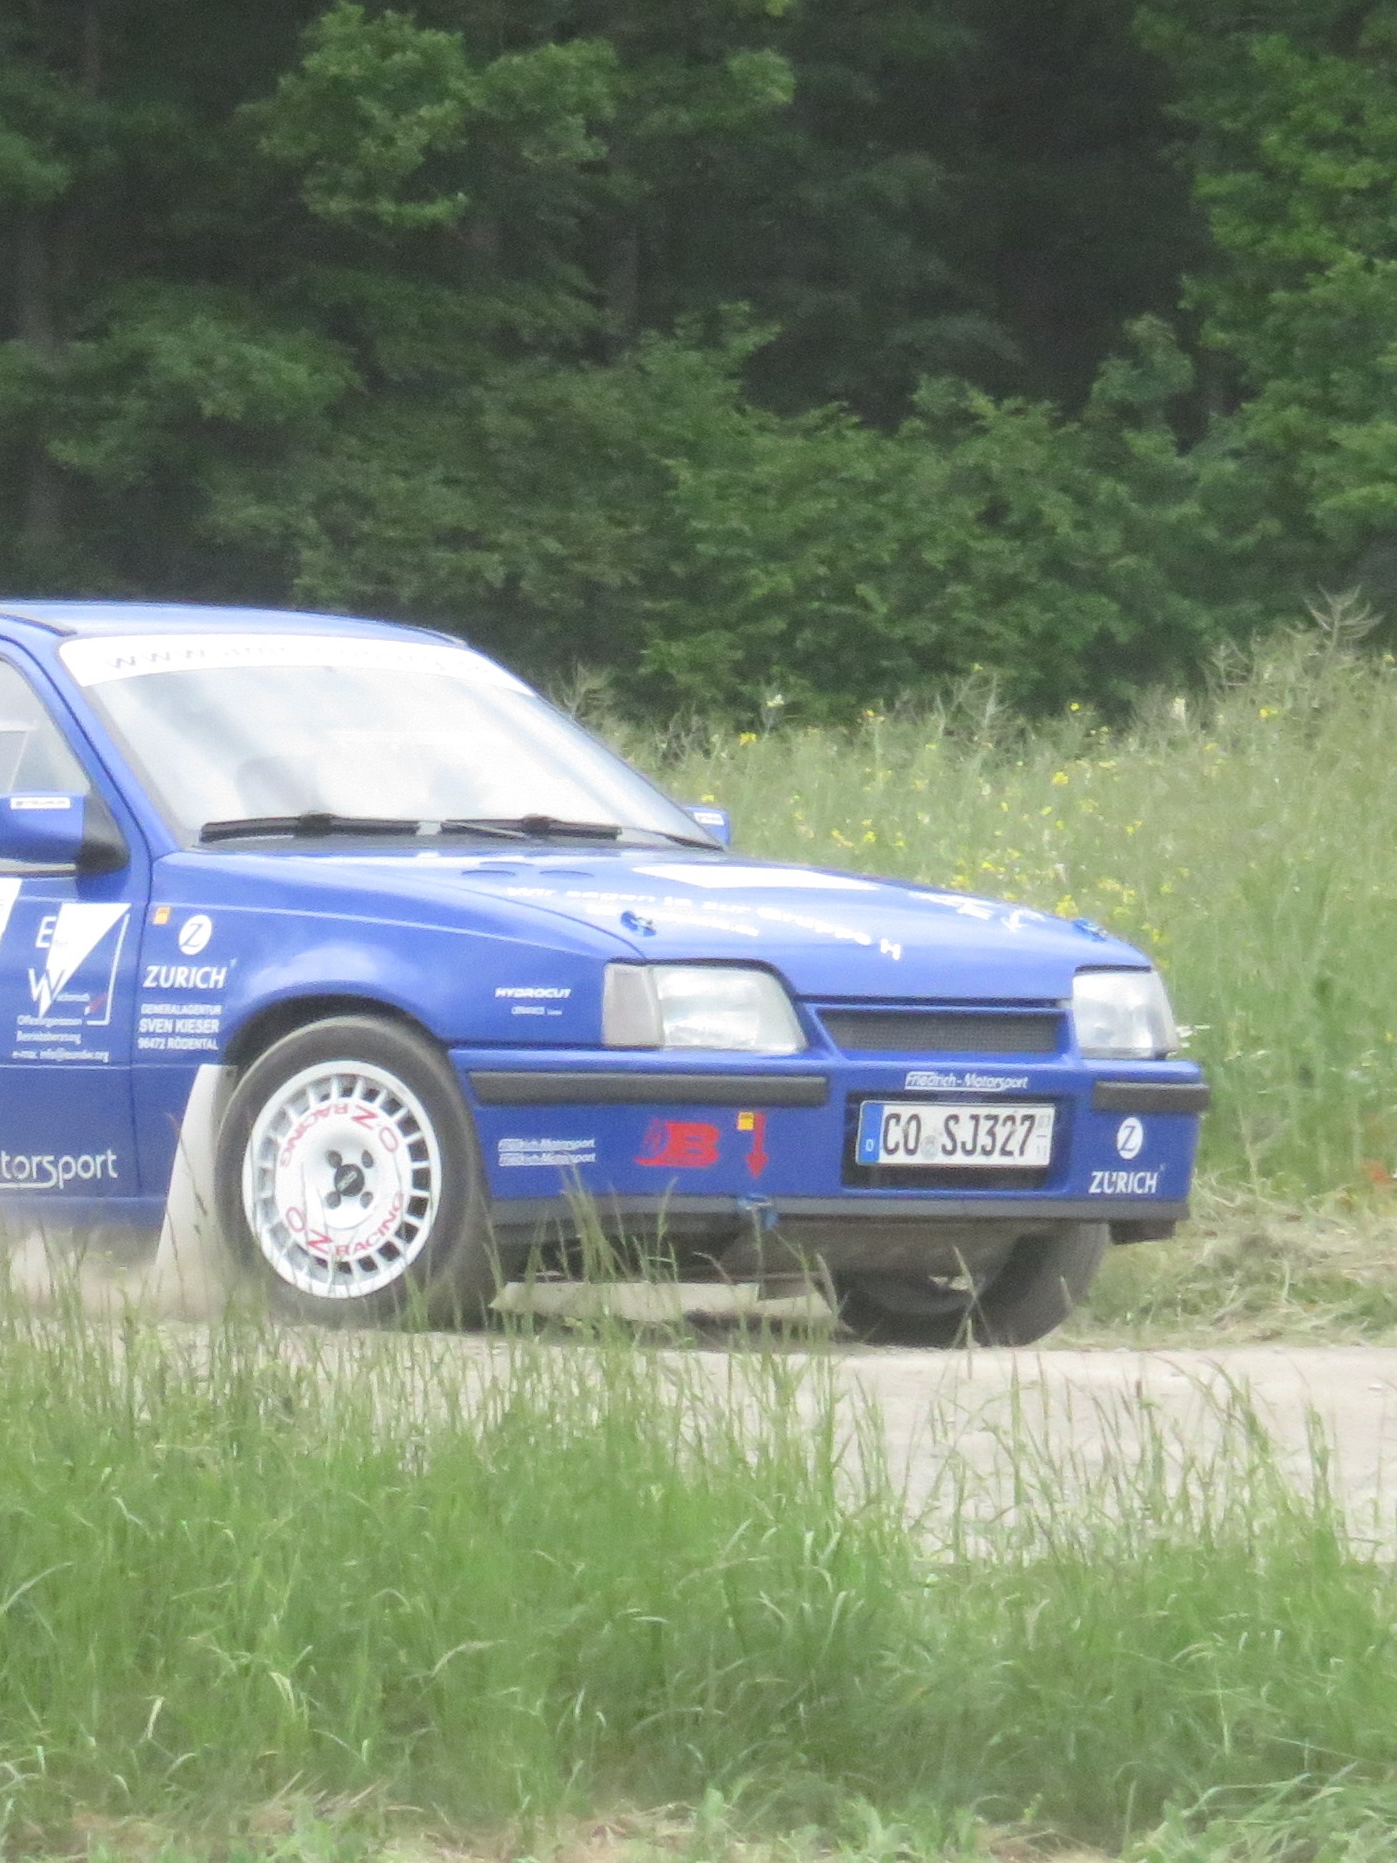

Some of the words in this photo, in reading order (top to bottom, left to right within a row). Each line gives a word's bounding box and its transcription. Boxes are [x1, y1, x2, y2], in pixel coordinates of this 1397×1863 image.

[143, 965, 227, 988] ZURICH
[494, 987, 571, 998] HYDROCUT
[139, 1019, 173, 1033] SVEN
[175, 1019, 220, 1033] KIESER
[883, 1113, 922, 1156] CO
[941, 1113, 1036, 1157] SJ327
[1089, 1171, 1159, 1193] ZURICH
[336, 1193, 404, 1256] RACING
